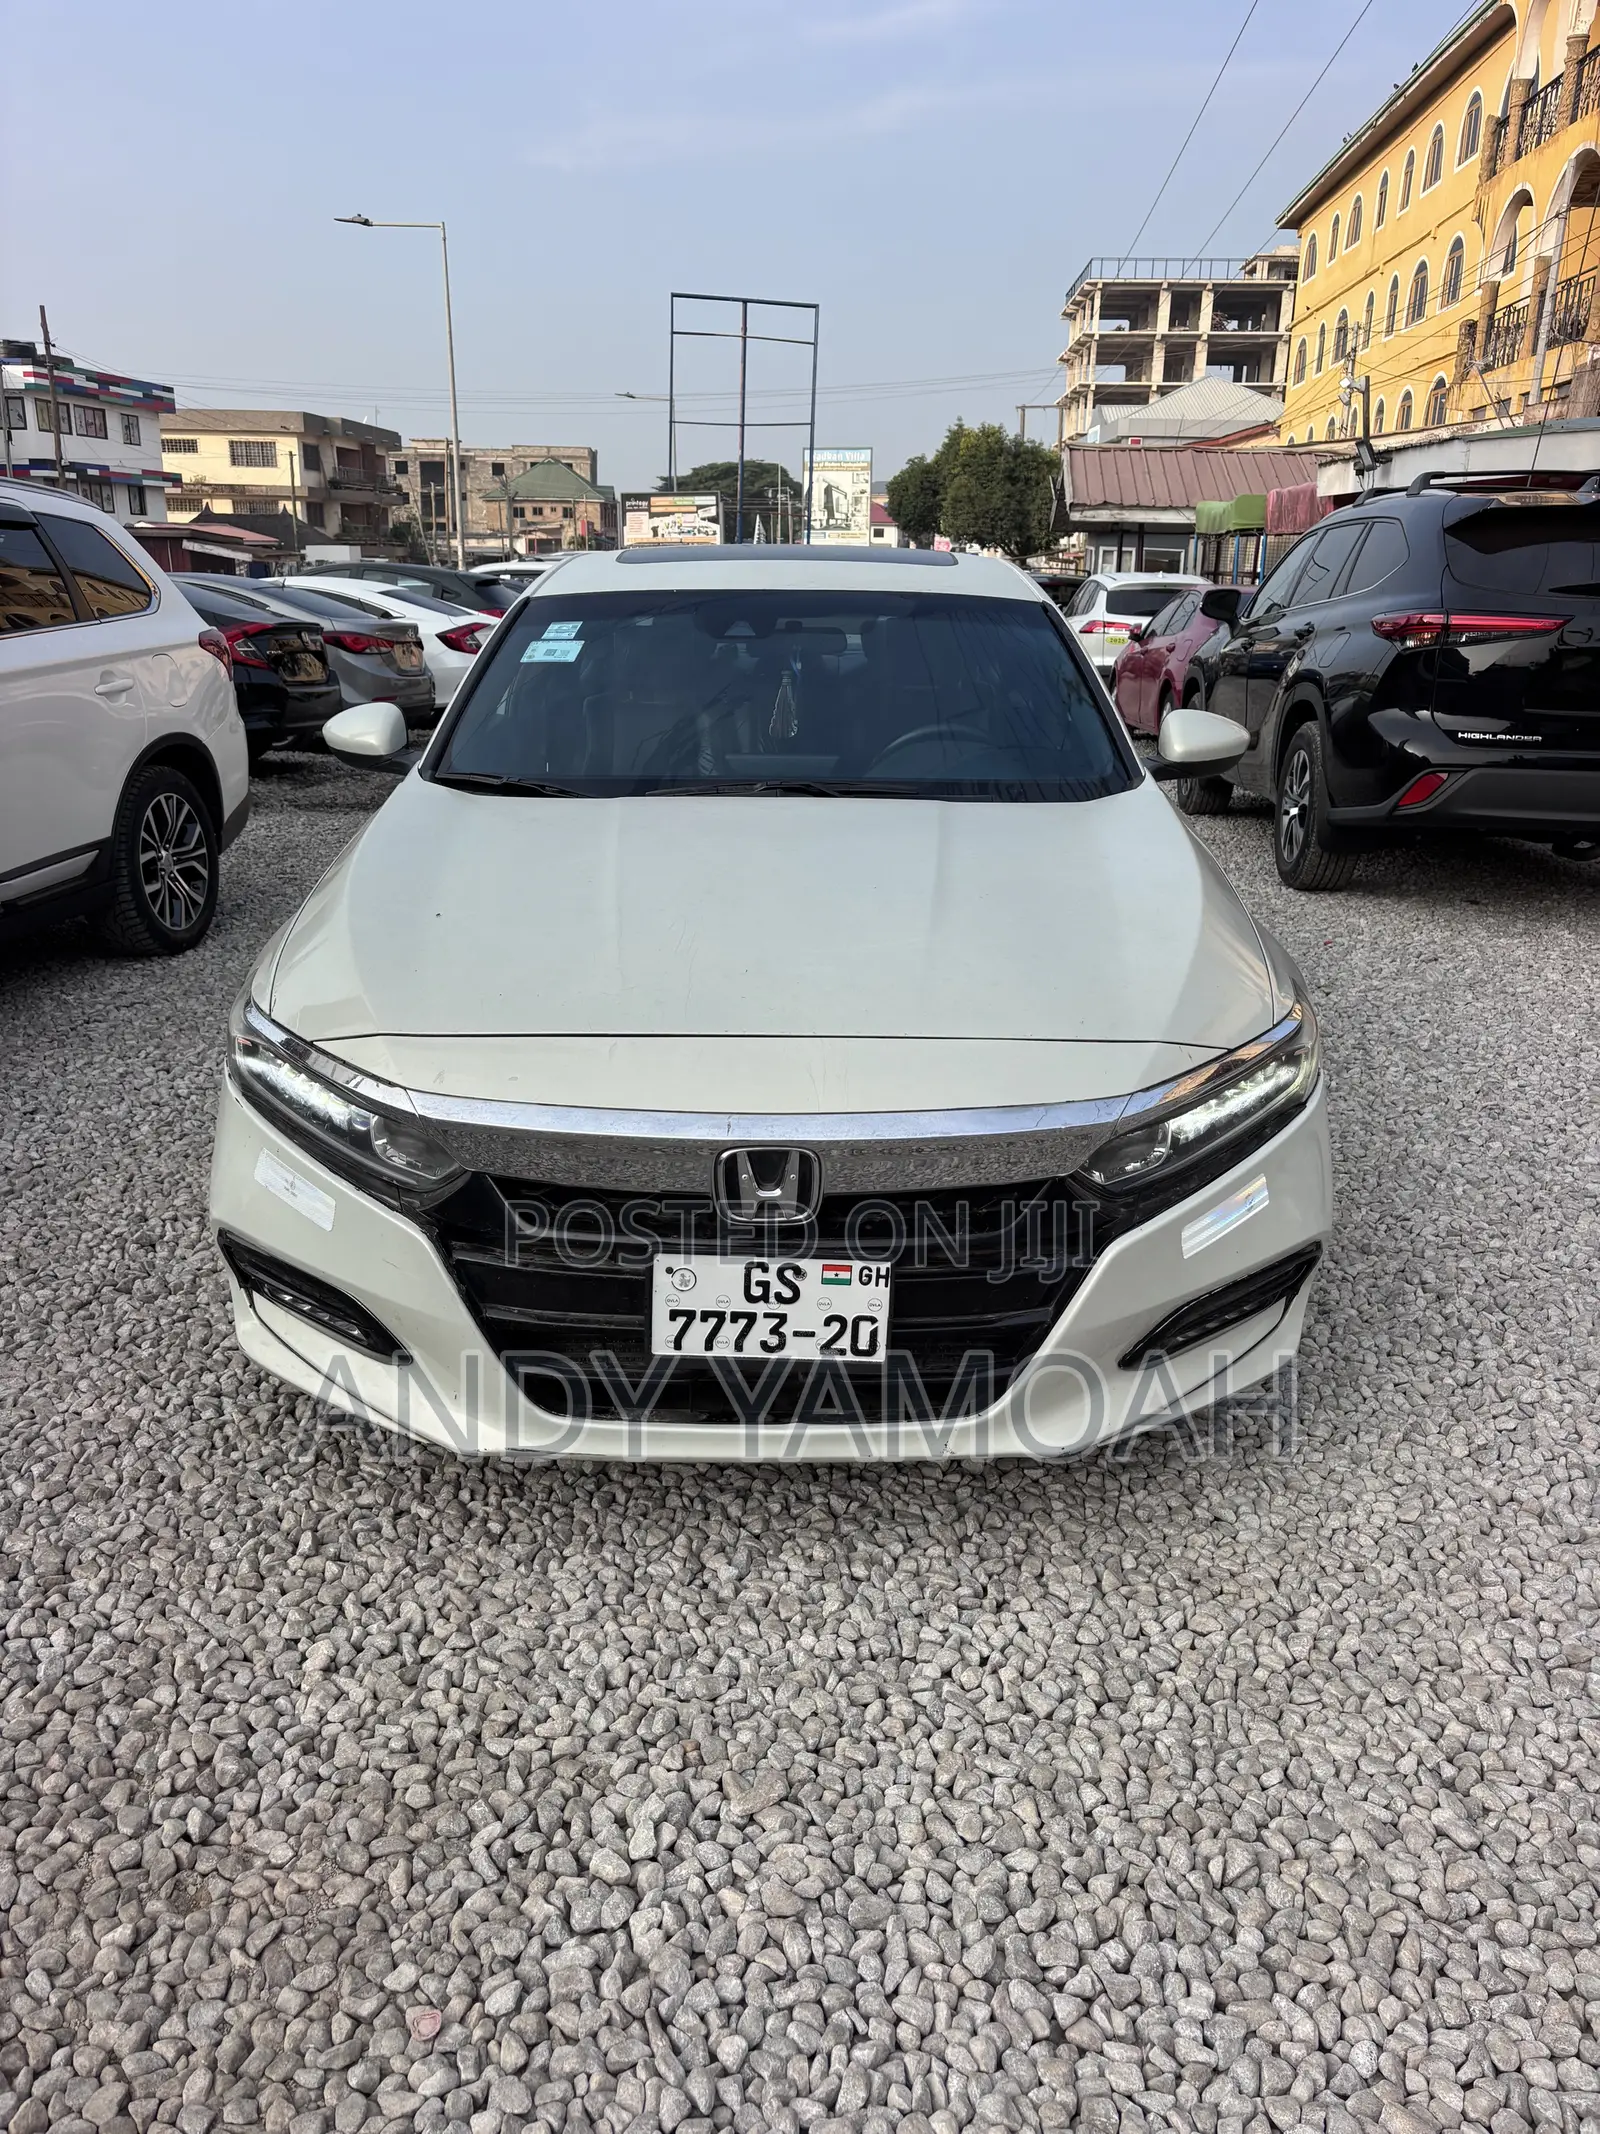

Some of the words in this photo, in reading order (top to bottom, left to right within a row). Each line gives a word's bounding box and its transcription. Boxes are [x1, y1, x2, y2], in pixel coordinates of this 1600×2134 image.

[1457, 731, 1543, 742] HIGHLANDER
[743, 1260, 801, 1304] GS
[858, 1265, 890, 1288] GH
[668, 1309, 879, 1357] 7773-20
